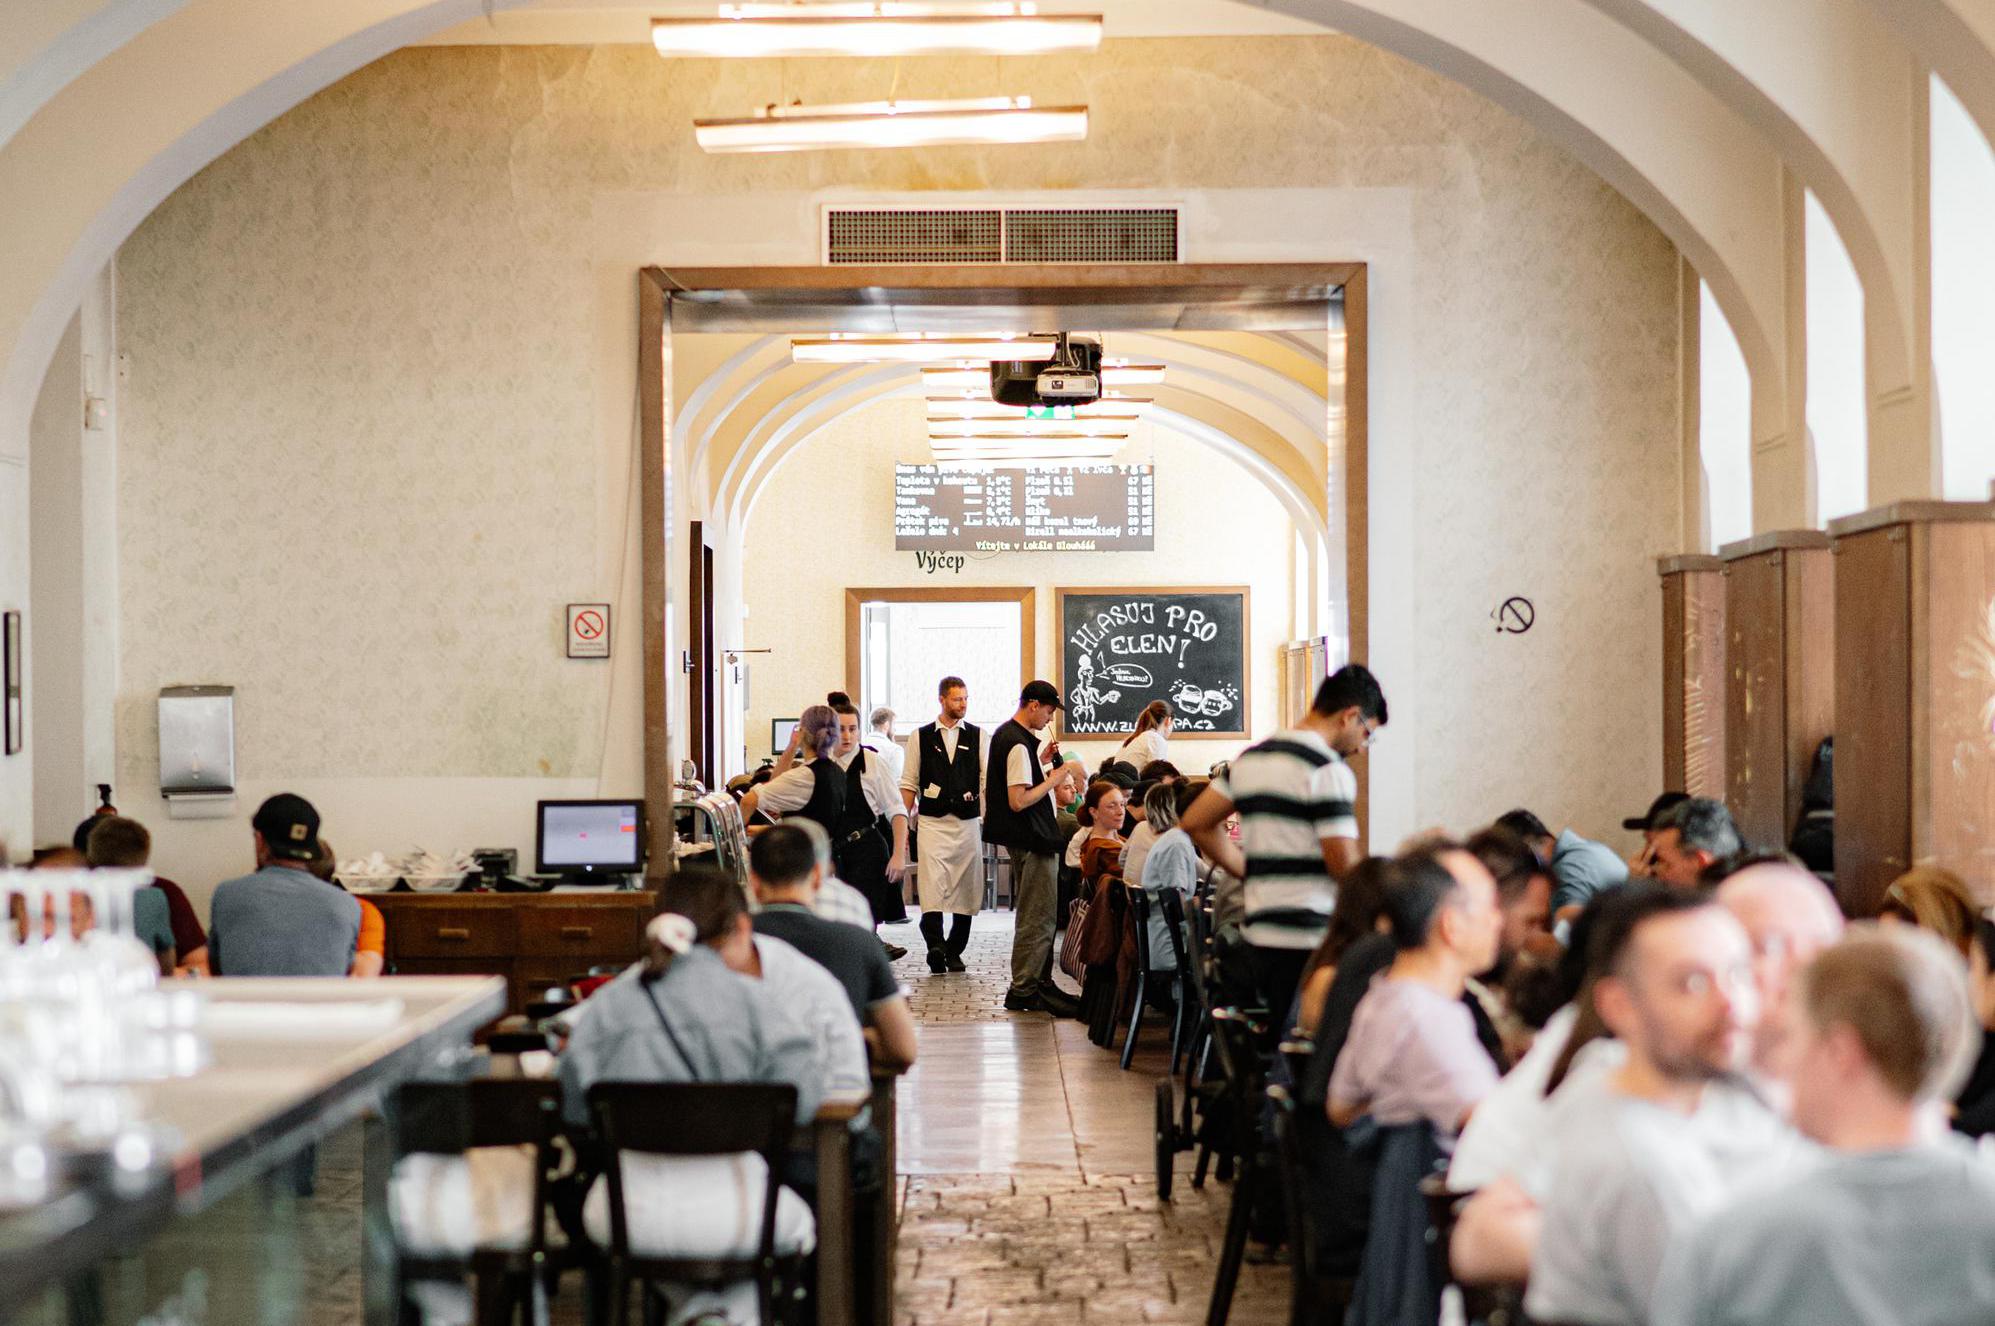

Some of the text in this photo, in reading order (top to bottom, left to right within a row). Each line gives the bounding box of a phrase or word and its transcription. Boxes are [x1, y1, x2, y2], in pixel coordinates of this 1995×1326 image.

[896, 476, 930, 486] Teplota
[934, 477, 940, 485] v
[976, 540, 1010, 552] Vítejte
[1024, 540, 1053, 549] Lokále
[915, 550, 965, 574] Výčep
[1070, 602, 1218, 656] HLASUJ PRO
